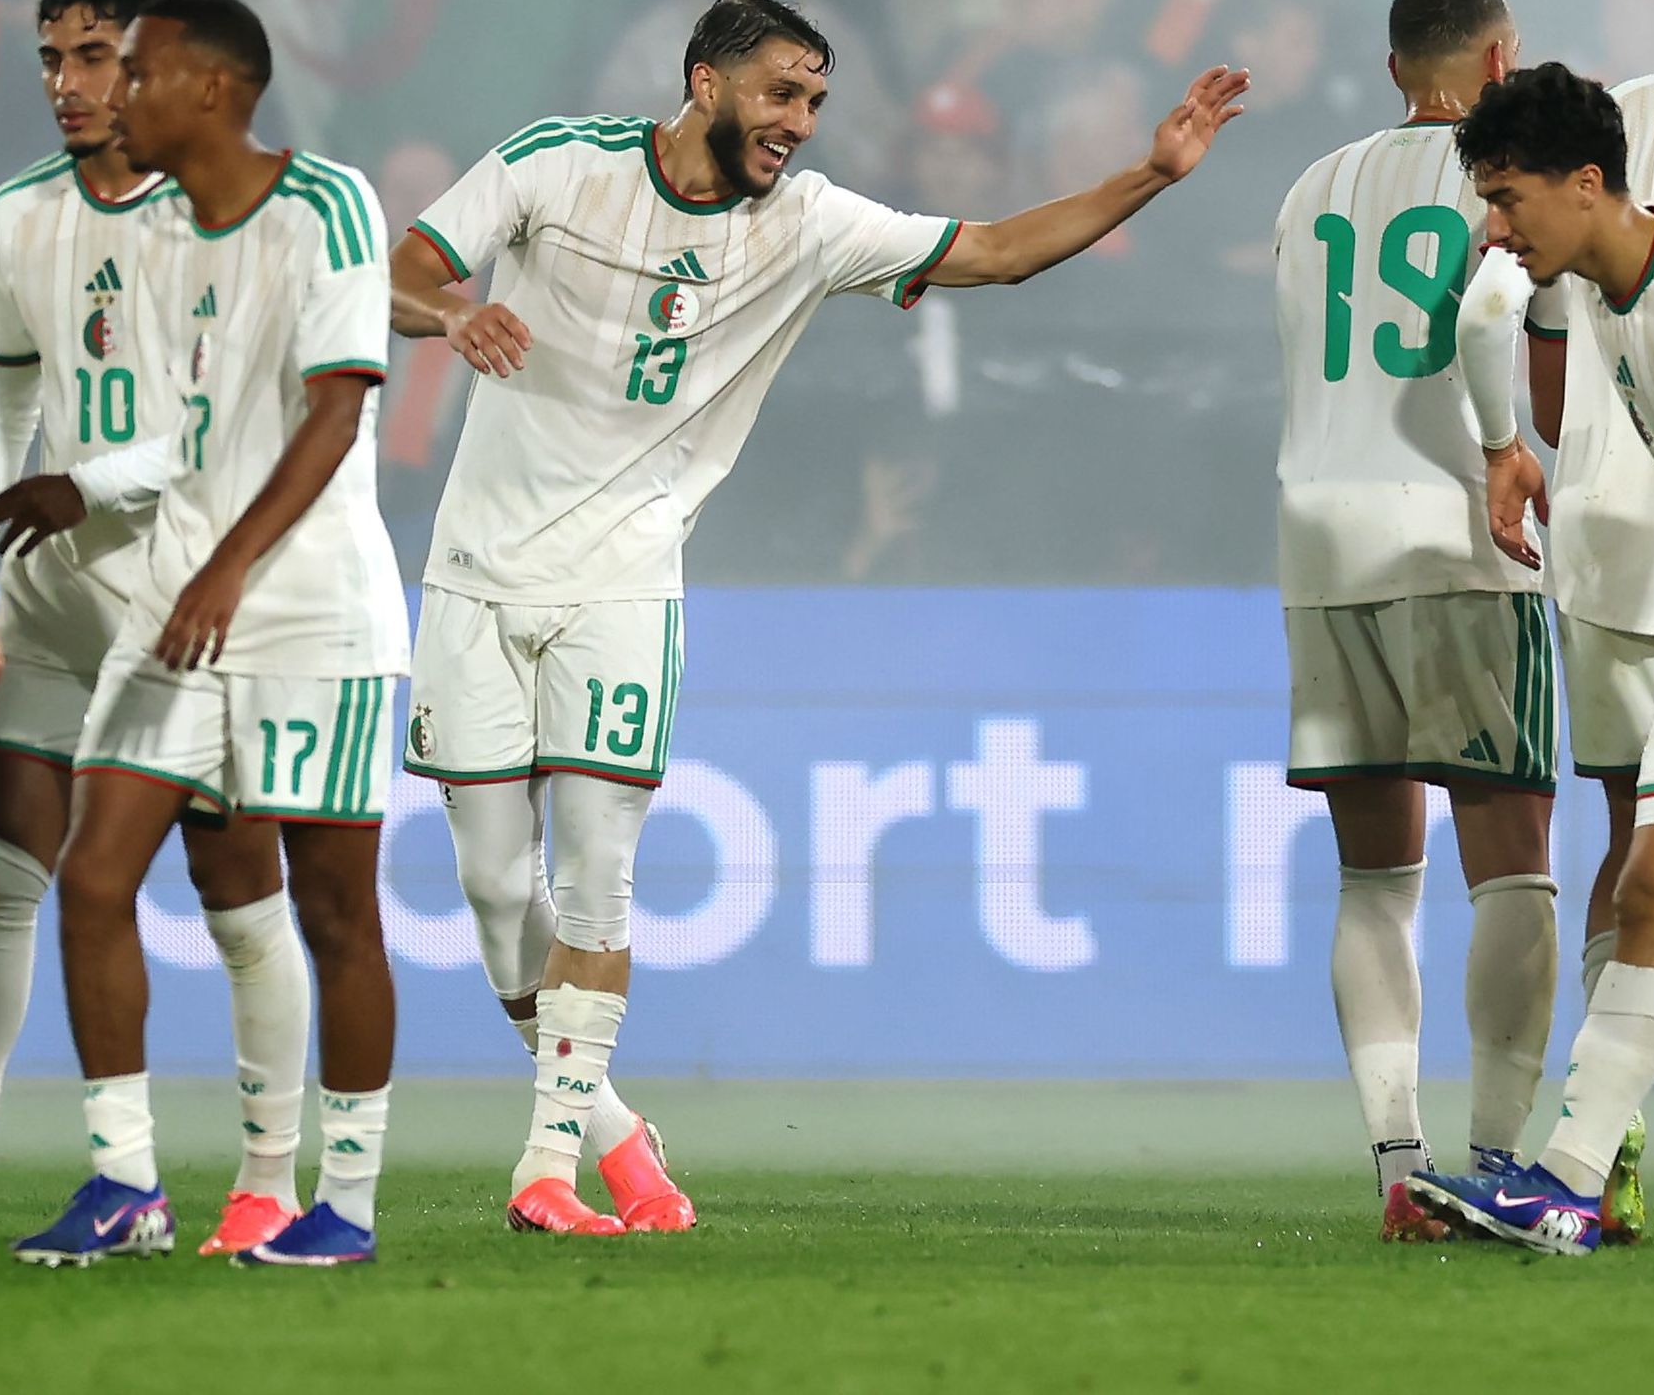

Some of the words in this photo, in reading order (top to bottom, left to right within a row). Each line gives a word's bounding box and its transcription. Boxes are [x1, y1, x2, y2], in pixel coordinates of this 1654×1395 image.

[1313, 204, 1471, 383] 19
[75, 367, 136, 444] 10
[625, 332, 688, 405] 13
[585, 678, 648, 757] 13
[258, 718, 318, 795] 17
[555, 1075, 597, 1095] FAF
